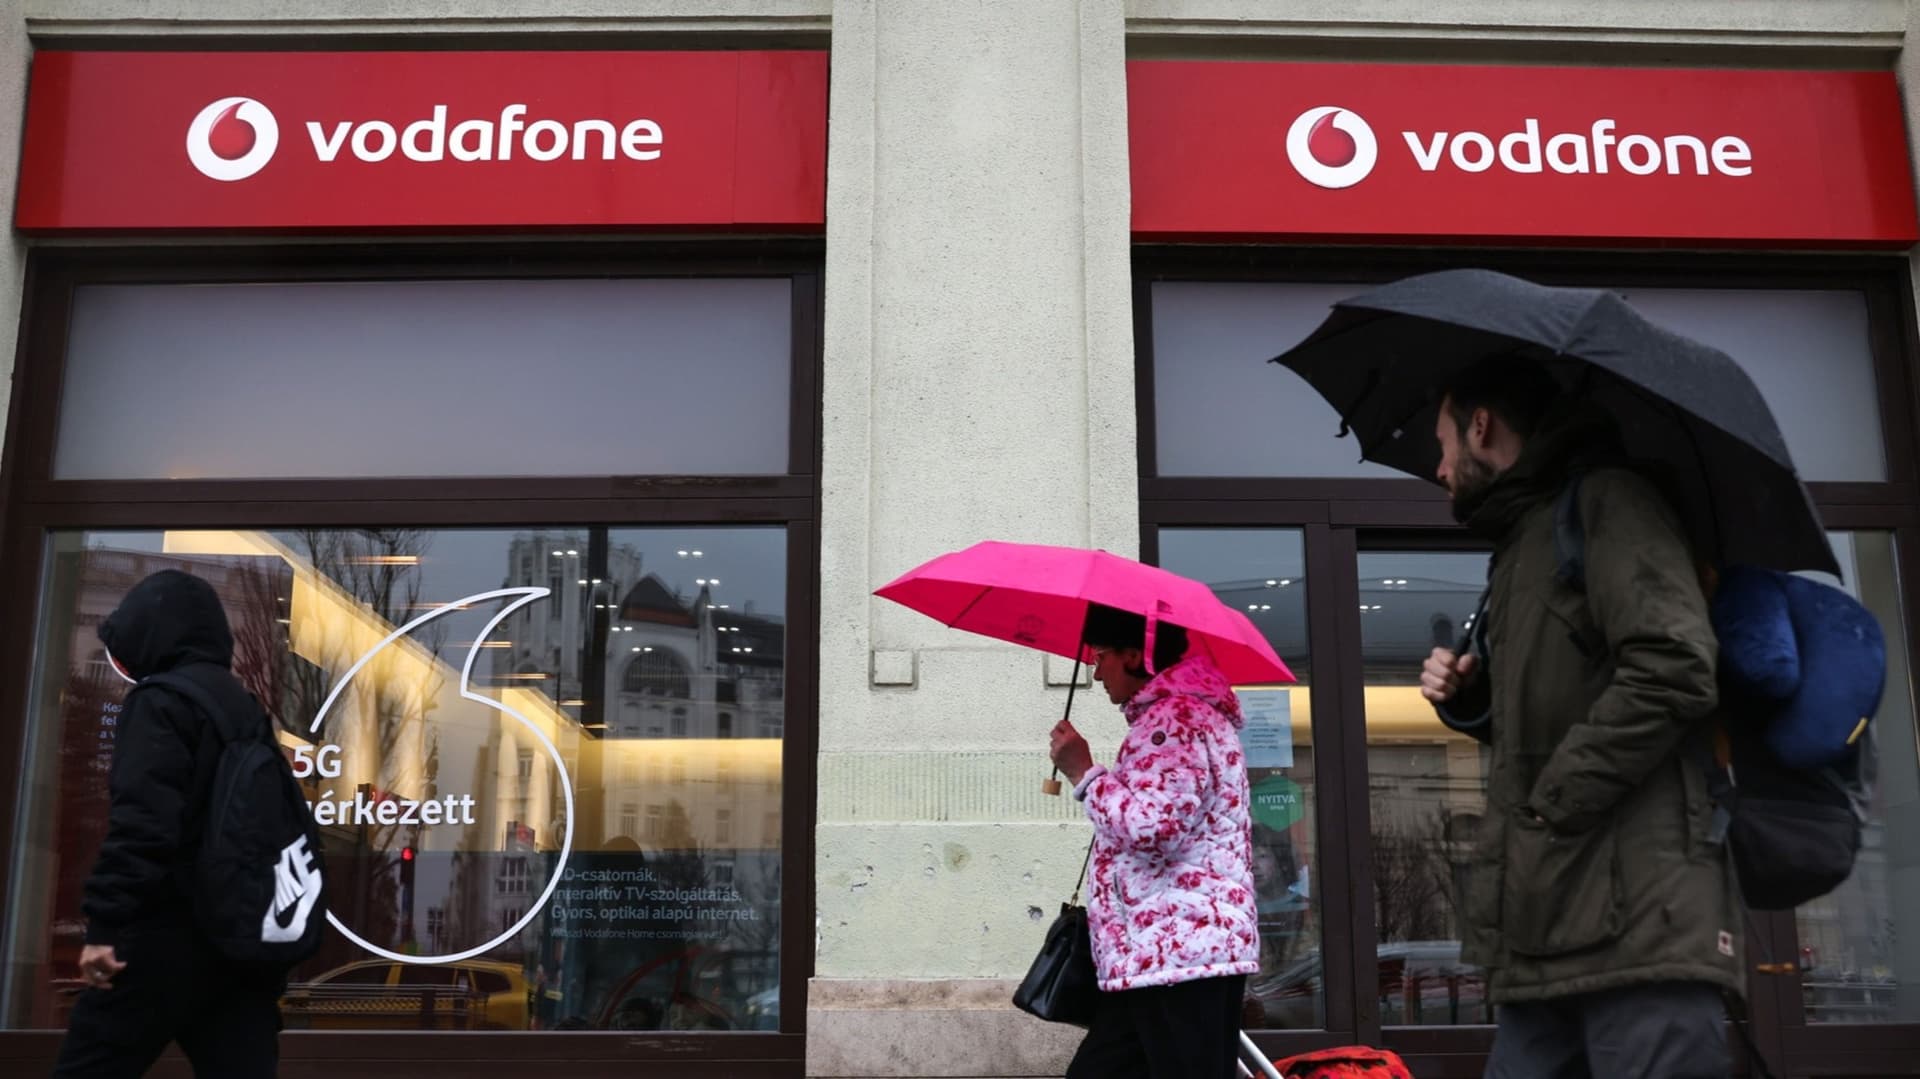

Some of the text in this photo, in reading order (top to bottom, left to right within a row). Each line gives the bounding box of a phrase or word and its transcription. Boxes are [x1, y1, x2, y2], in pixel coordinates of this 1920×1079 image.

[305, 104, 663, 162] vodafone
[1401, 118, 1753, 177] vodafone
[292, 744, 342, 779] 5G
[305, 789, 476, 826] érkezett
[1257, 794, 1296, 804] NYITVA
[272, 833, 321, 916] NIKE
[559, 867, 657, 882] D-csatornák.
[625, 886, 742, 905] TV-szolgáltatás.
[551, 904, 760, 924] Gyors, optikai alapú internet.
[583, 928, 626, 938] Vodafone
[627, 928, 654, 938] Home
